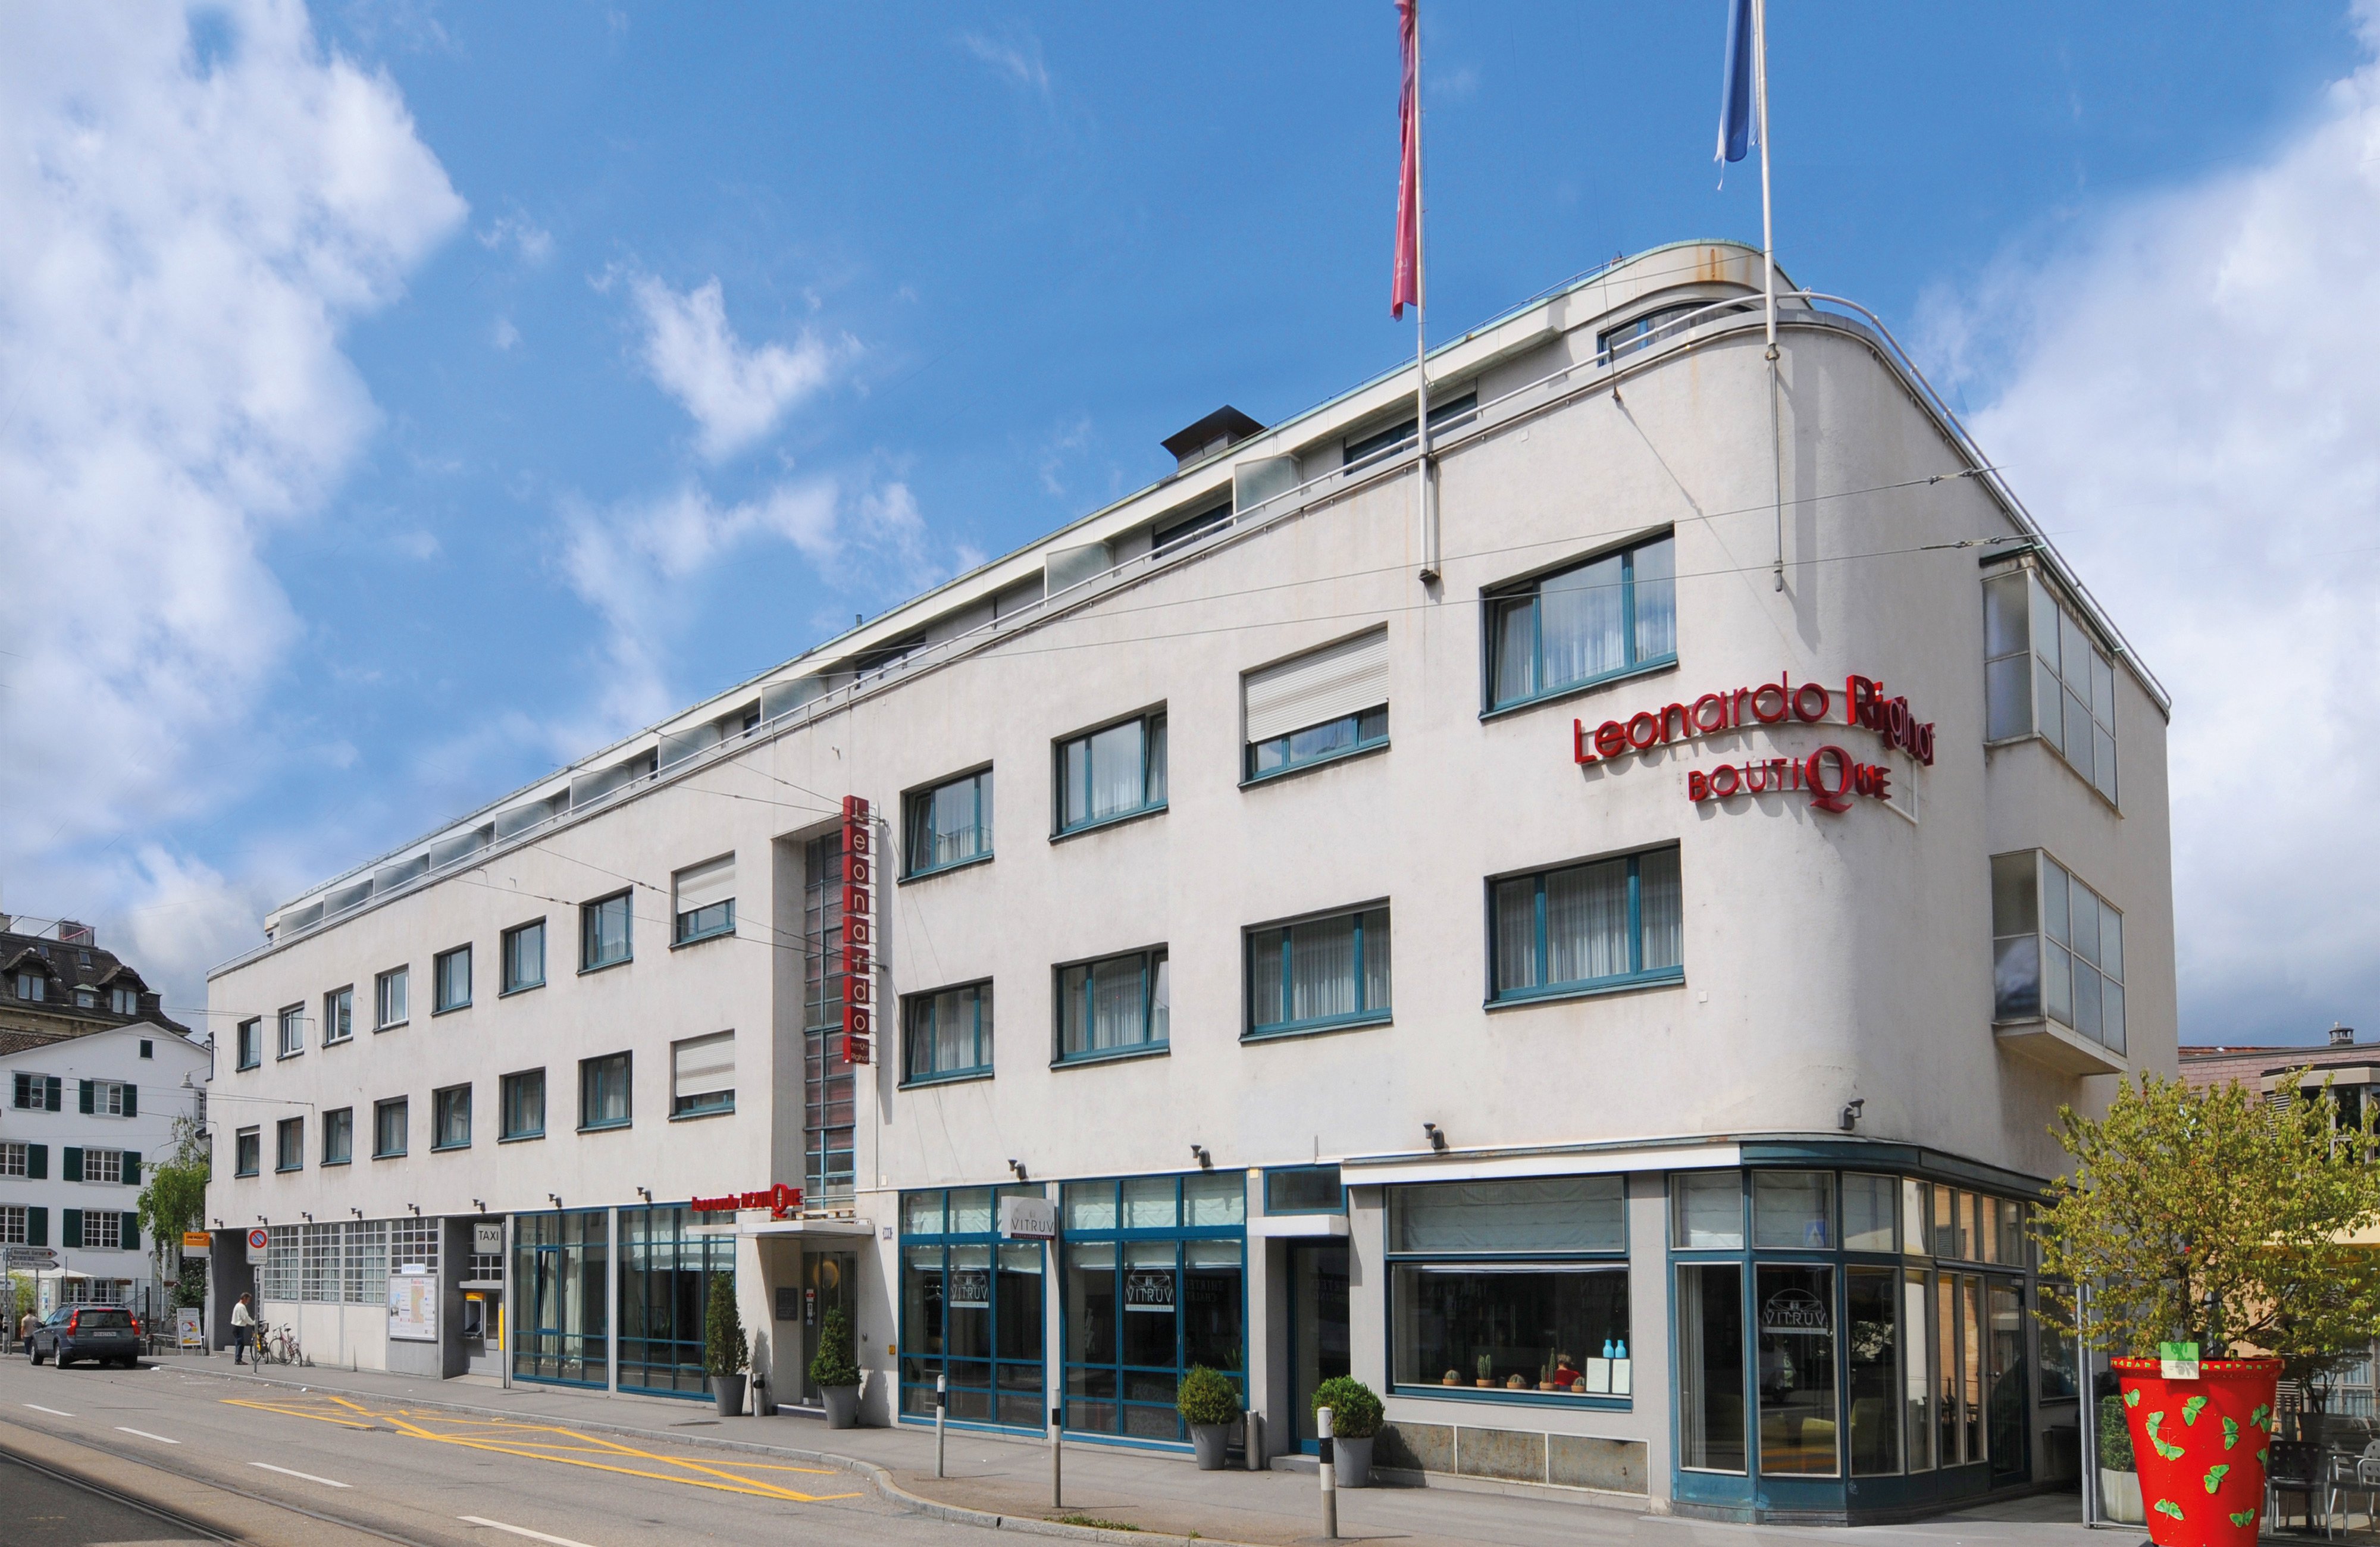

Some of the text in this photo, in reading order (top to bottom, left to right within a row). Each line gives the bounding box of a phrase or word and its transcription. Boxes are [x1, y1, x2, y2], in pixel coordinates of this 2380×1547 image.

[1574, 671, 1936, 766] Leonardo Righof
[1689, 745, 1892, 813] BOUTIQUE
[852, 799, 866, 1031] Leonardo
[1012, 1218, 1054, 1232] VITRUV
[478, 1230, 499, 1241] TAXI
[951, 1286, 988, 1300] VITRUV
[1126, 1288, 1173, 1302] VITRUV
[1764, 1311, 1827, 1326] VITRUV
